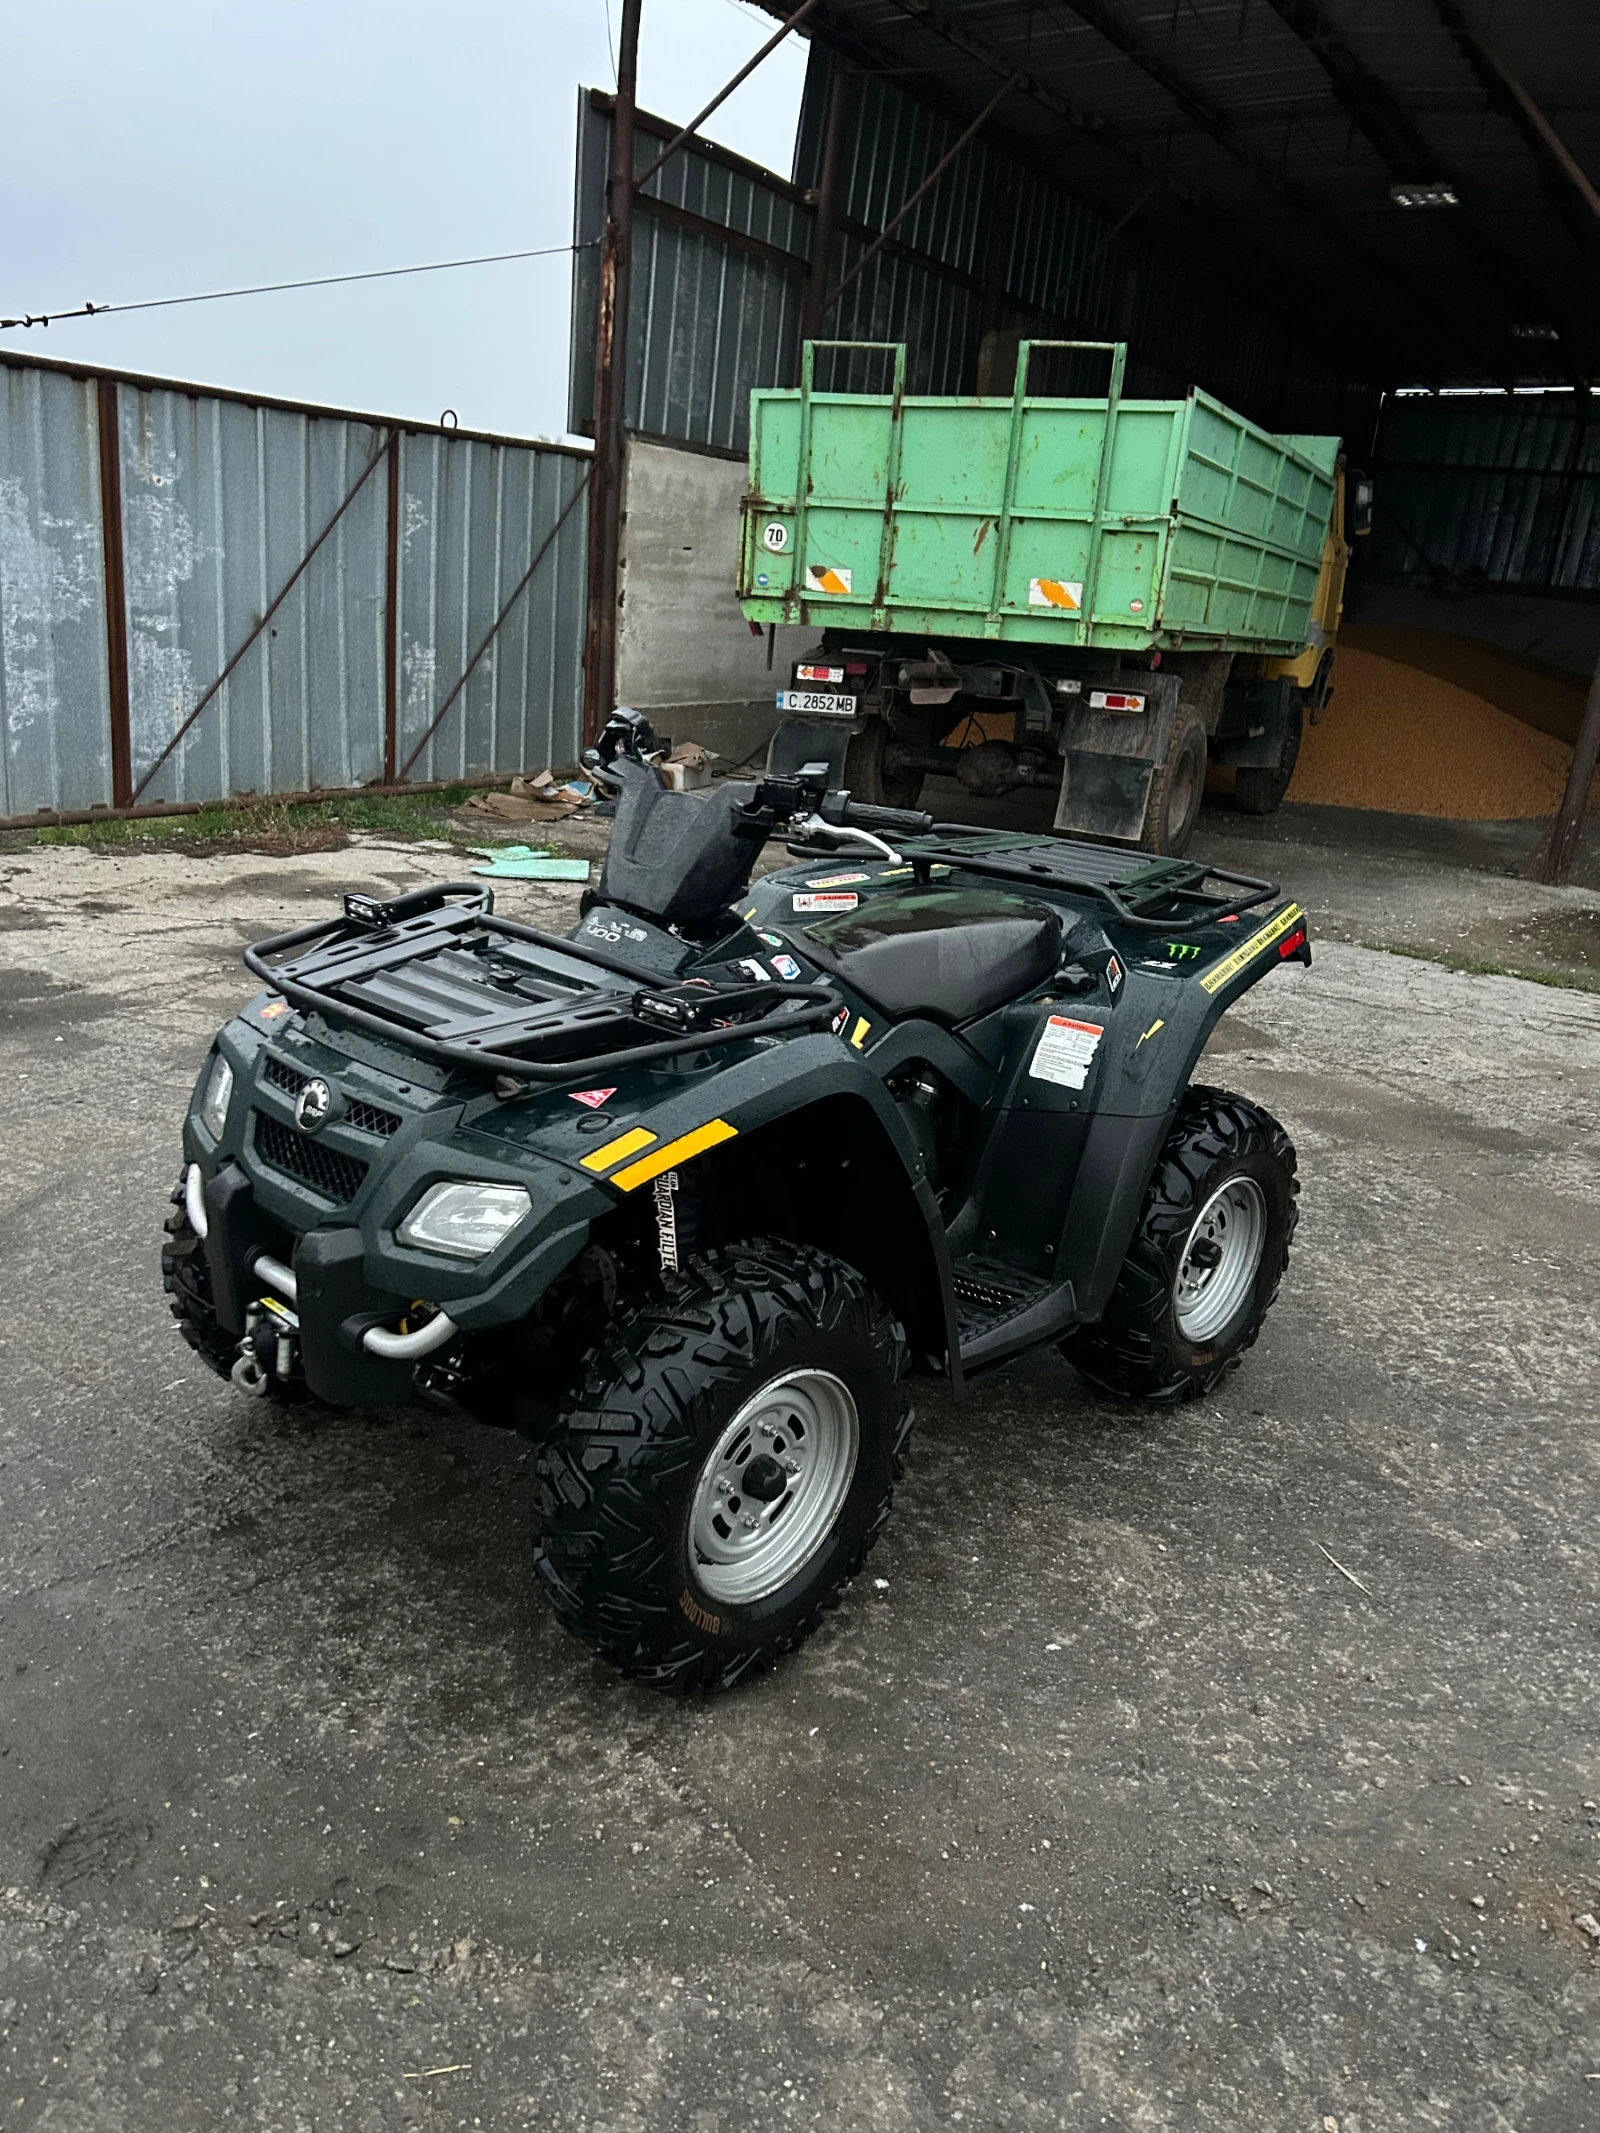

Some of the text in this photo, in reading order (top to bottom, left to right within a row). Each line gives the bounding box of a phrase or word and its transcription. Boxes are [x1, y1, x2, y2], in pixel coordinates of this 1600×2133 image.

[768, 528, 783, 542] 70
[305, 1105, 324, 1118] BRP
[670, 1173, 678, 1189] TEAM
[656, 1173, 673, 1229] GUARDIAN
[679, 1588, 720, 1634] BULLDOG
